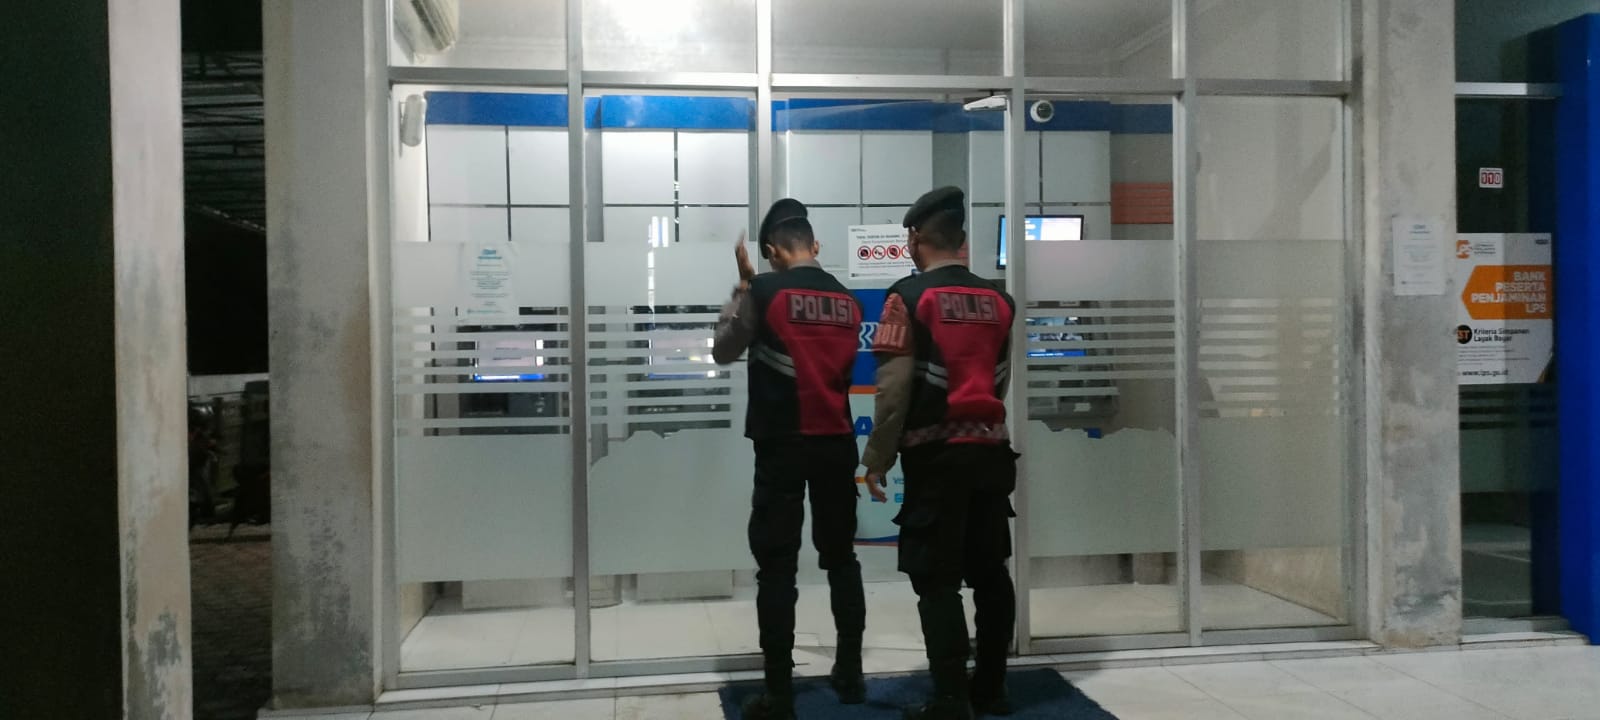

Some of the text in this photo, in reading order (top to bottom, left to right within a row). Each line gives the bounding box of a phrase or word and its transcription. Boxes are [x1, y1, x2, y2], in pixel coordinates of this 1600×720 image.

[1514, 271, 1546, 281] BANK
[1495, 282, 1546, 292] PESERTA
[1471, 293, 1546, 303] PENJAMINAN
[790, 294, 853, 324] POLISI
[939, 293, 999, 321] POLISI
[1526, 303, 1546, 313] LPS
